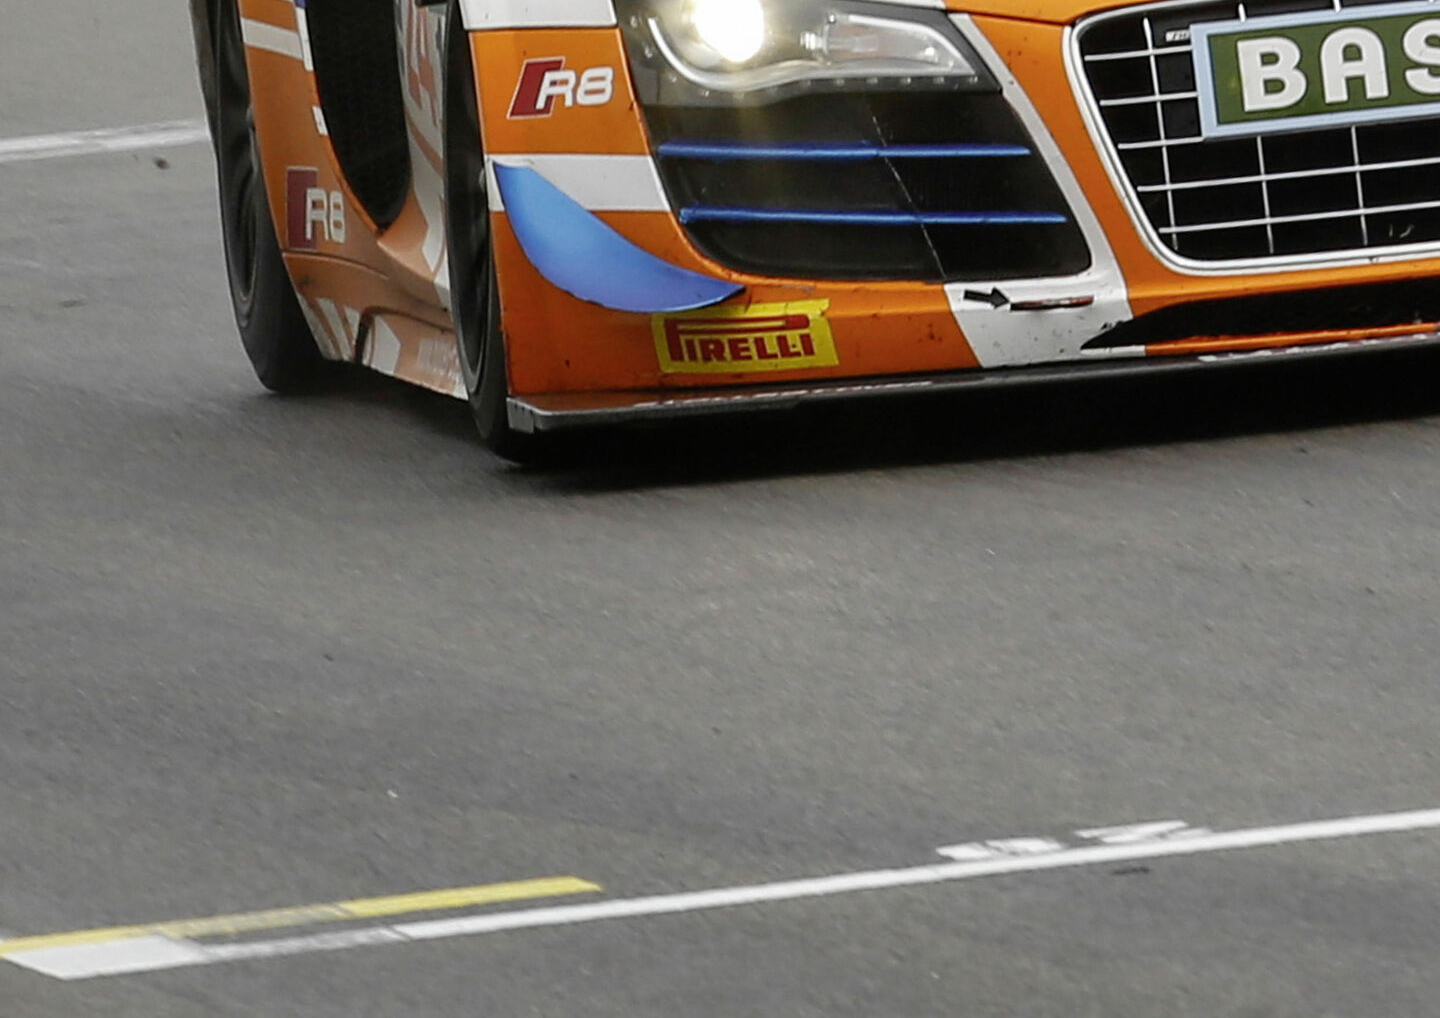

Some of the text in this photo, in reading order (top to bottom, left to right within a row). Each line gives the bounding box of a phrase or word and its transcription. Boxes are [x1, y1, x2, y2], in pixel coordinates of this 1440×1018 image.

[534, 66, 614, 112] R8
[304, 187, 347, 245] R8
[663, 313, 816, 364] PIRELLI
